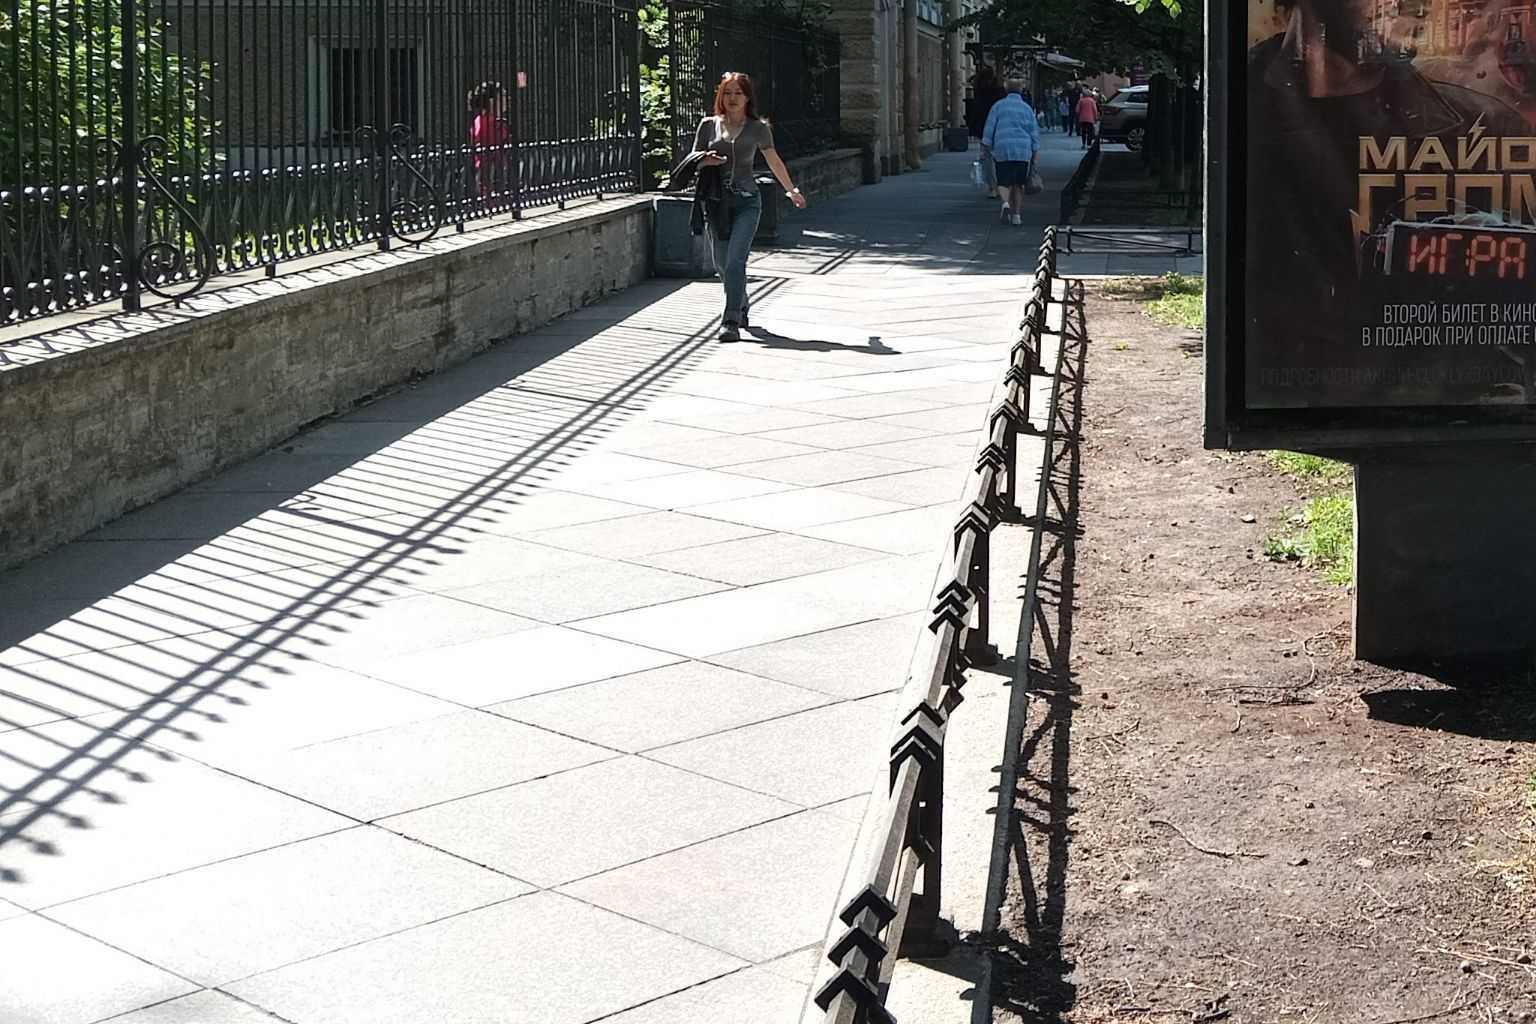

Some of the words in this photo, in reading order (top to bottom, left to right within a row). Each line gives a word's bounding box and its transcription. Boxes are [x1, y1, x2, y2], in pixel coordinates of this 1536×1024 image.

[1408, 233, 1526, 279] ИГРА
[1384, 300, 1437, 324] ВТОРОЙ
[1443, 303, 1486, 323] БИЛЕТ
[1491, 304, 1499, 322] В
[1363, 327, 1370, 346] В
[1376, 326, 1441, 348] ПОДАРОК
[1446, 326, 1473, 345] ПРИ
[1479, 325, 1530, 345] ОПЛАТЕ
